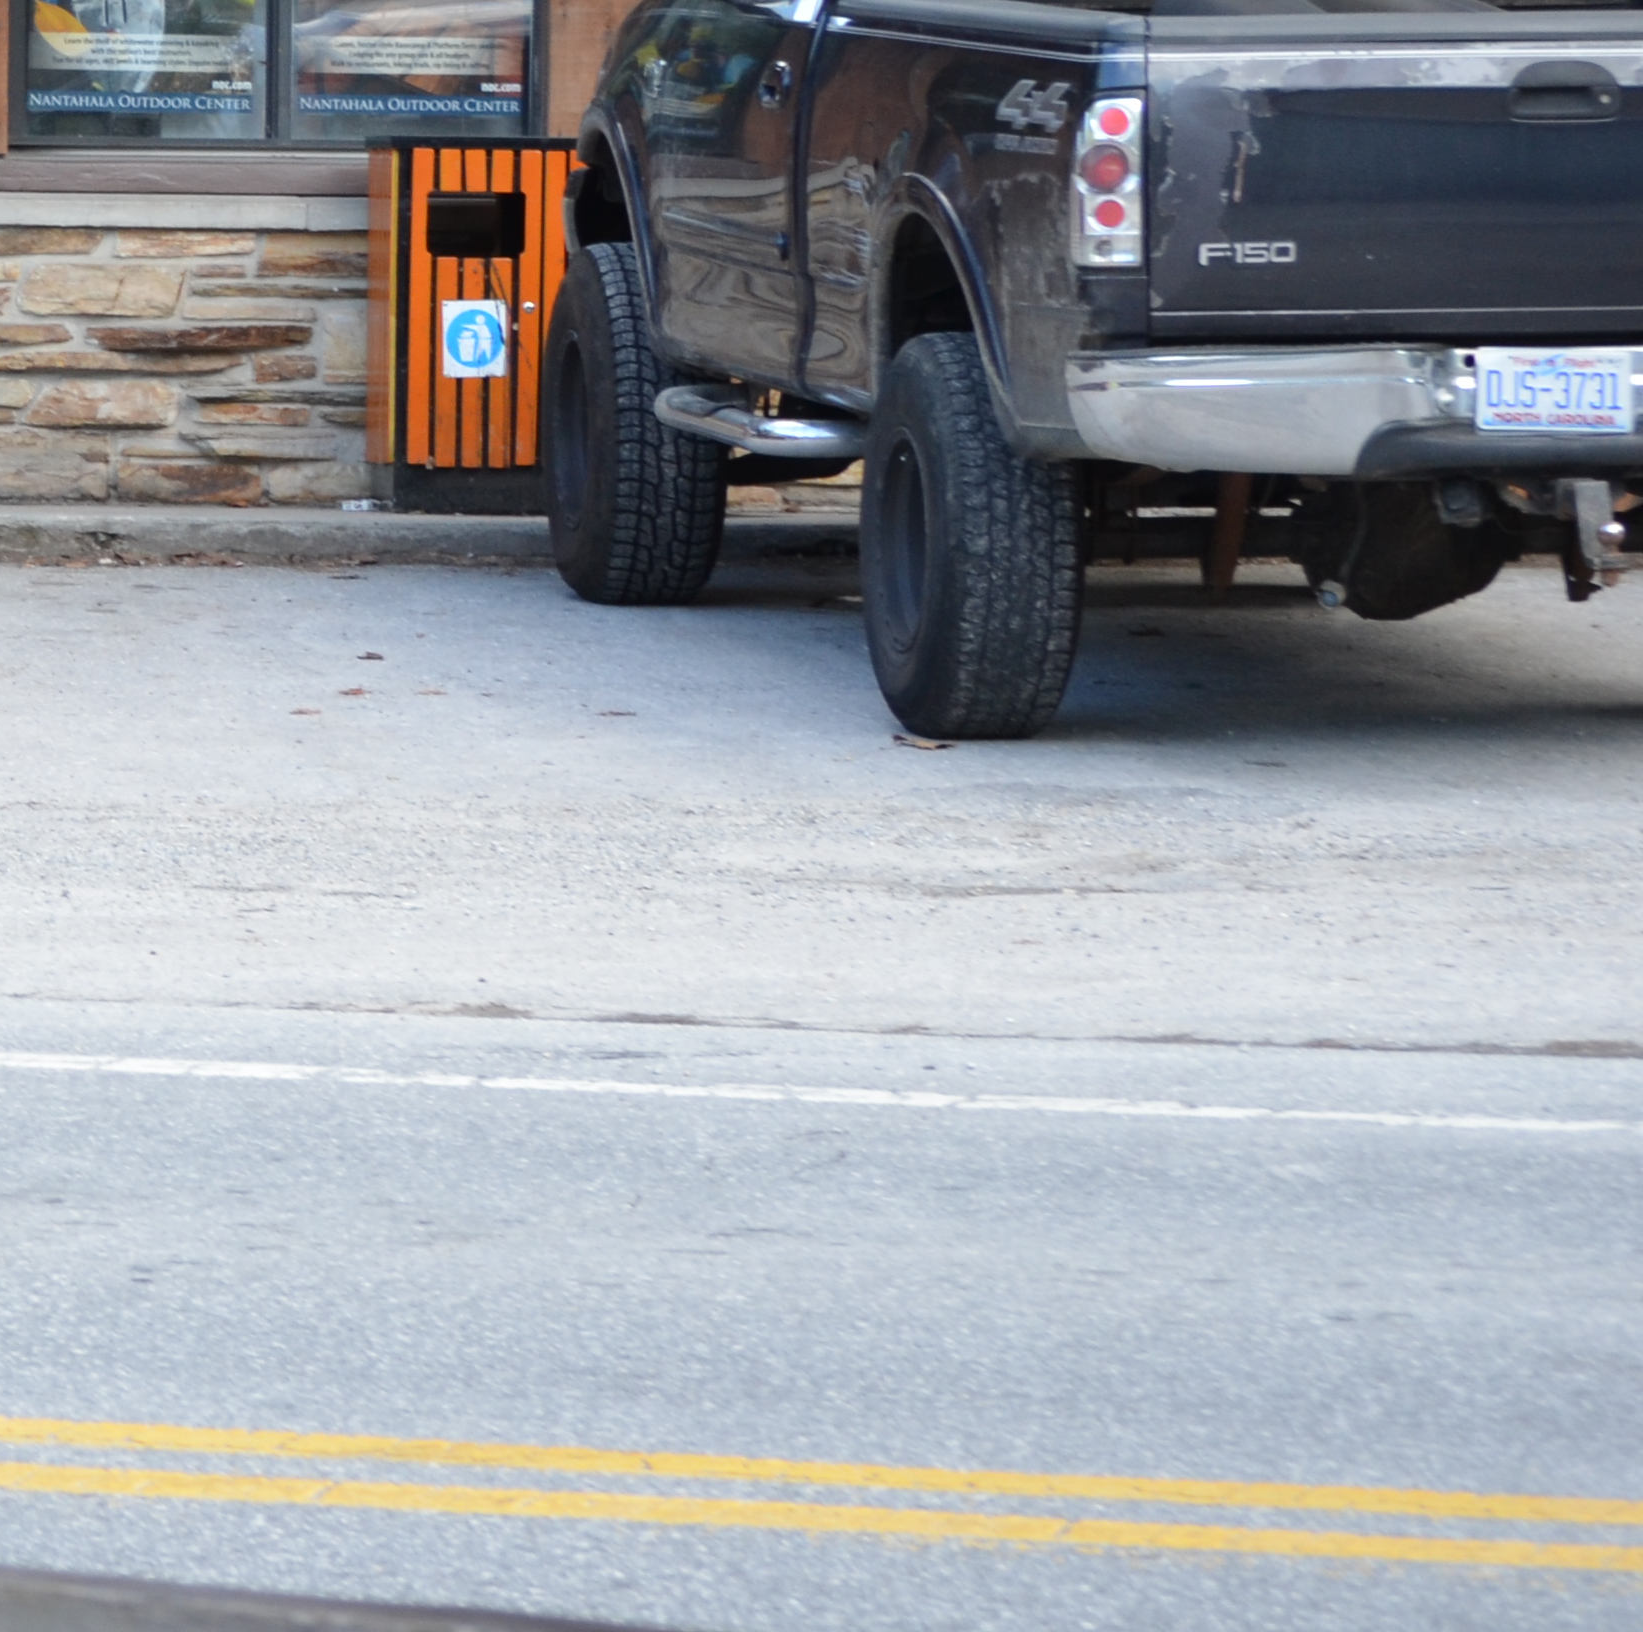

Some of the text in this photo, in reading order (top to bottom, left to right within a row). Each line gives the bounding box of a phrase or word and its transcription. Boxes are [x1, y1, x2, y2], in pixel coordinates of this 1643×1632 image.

[28, 92, 251, 110] NANTAHALA OUTDOOR CENTER
[299, 97, 520, 113] NANTAHALA OUTDOOR CENTER
[1487, 369, 1623, 410] DJS-3731
[1493, 411, 1541, 424] NORTH
